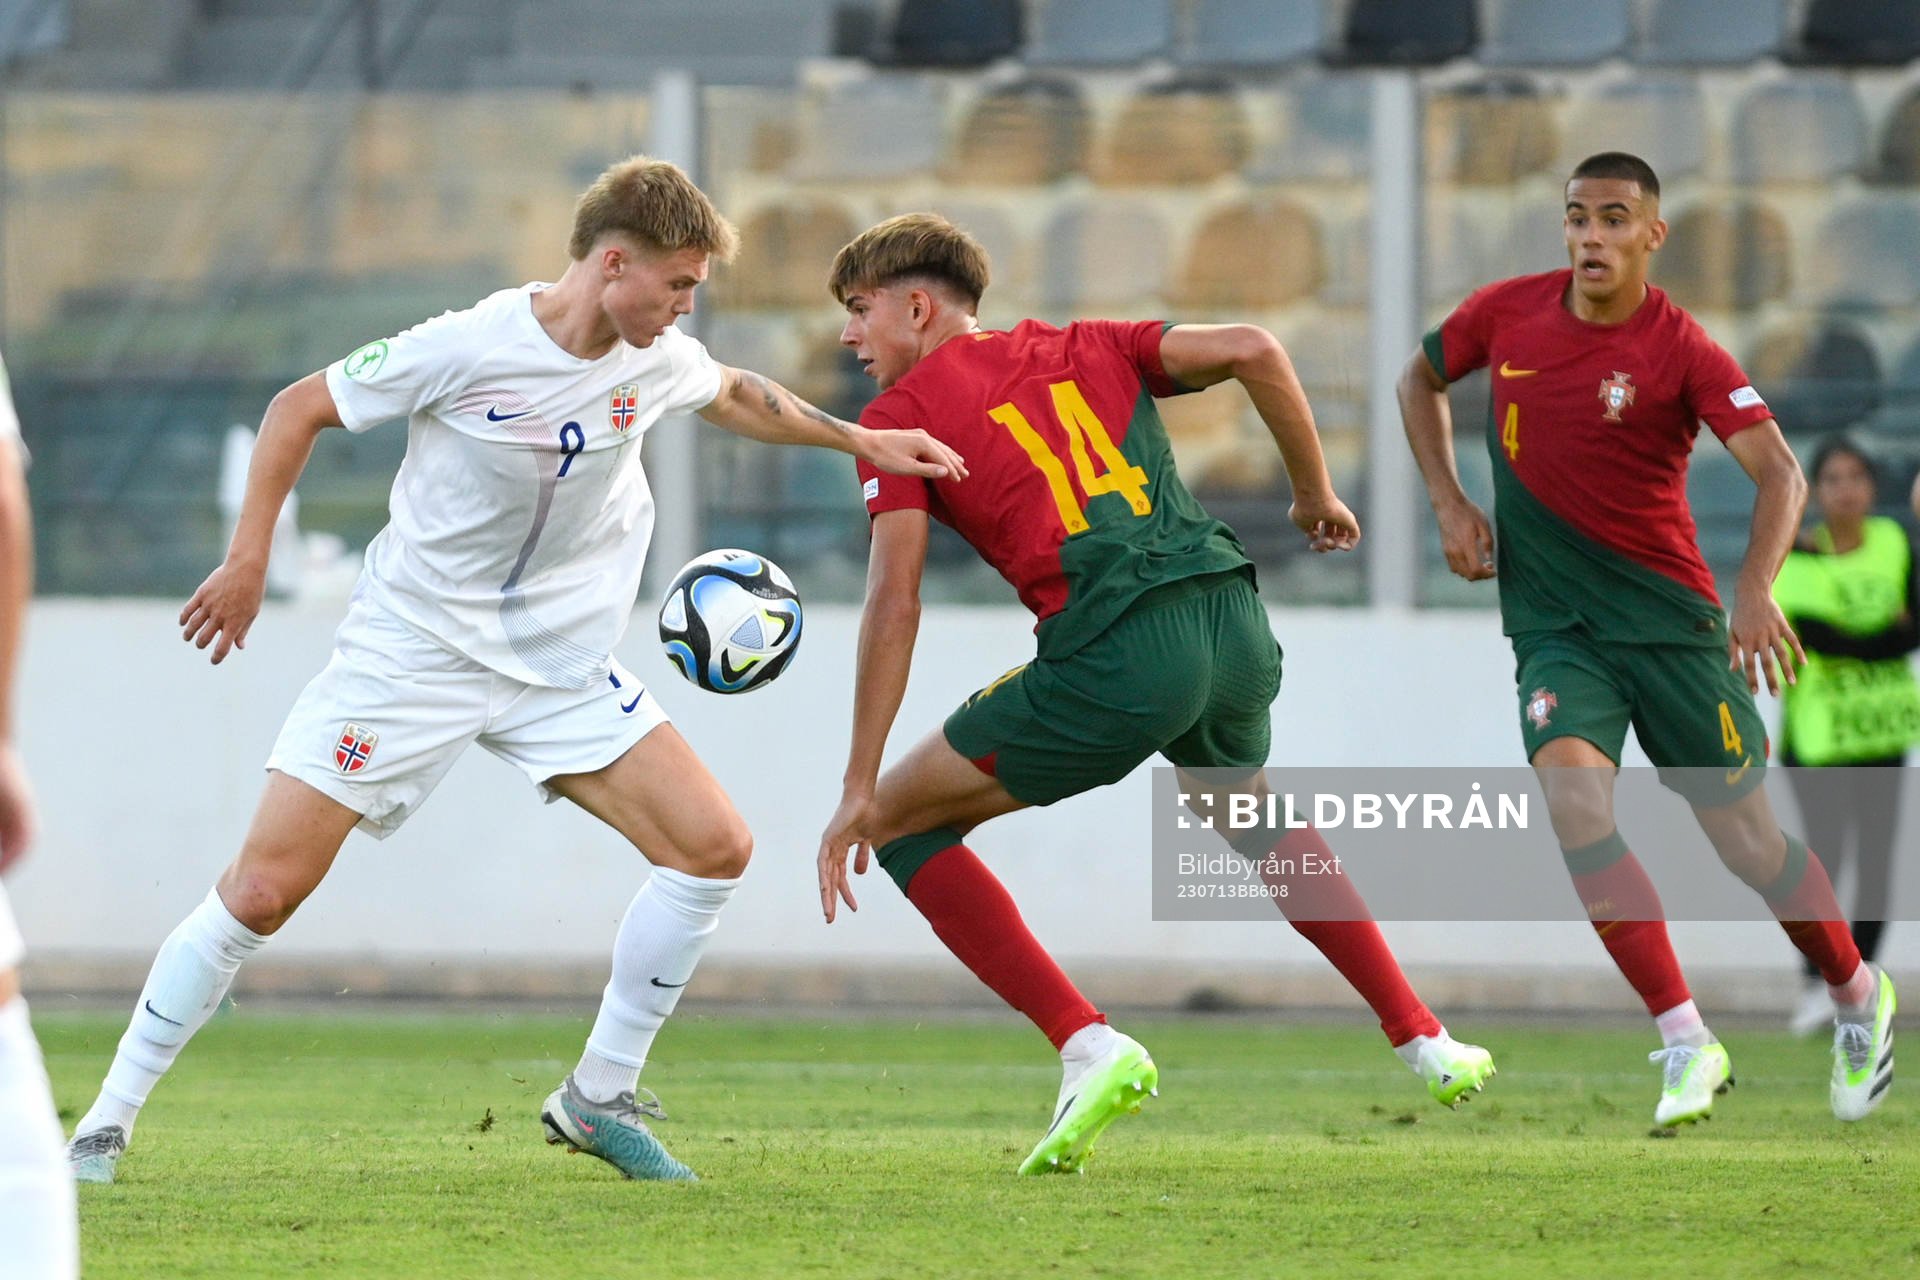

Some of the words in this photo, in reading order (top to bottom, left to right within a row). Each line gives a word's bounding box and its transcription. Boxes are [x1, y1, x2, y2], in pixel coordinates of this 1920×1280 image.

[557, 421, 586, 478] 9
[987, 379, 1152, 535] 14
[1502, 402, 1519, 460] 4
[1718, 700, 1743, 757] 4
